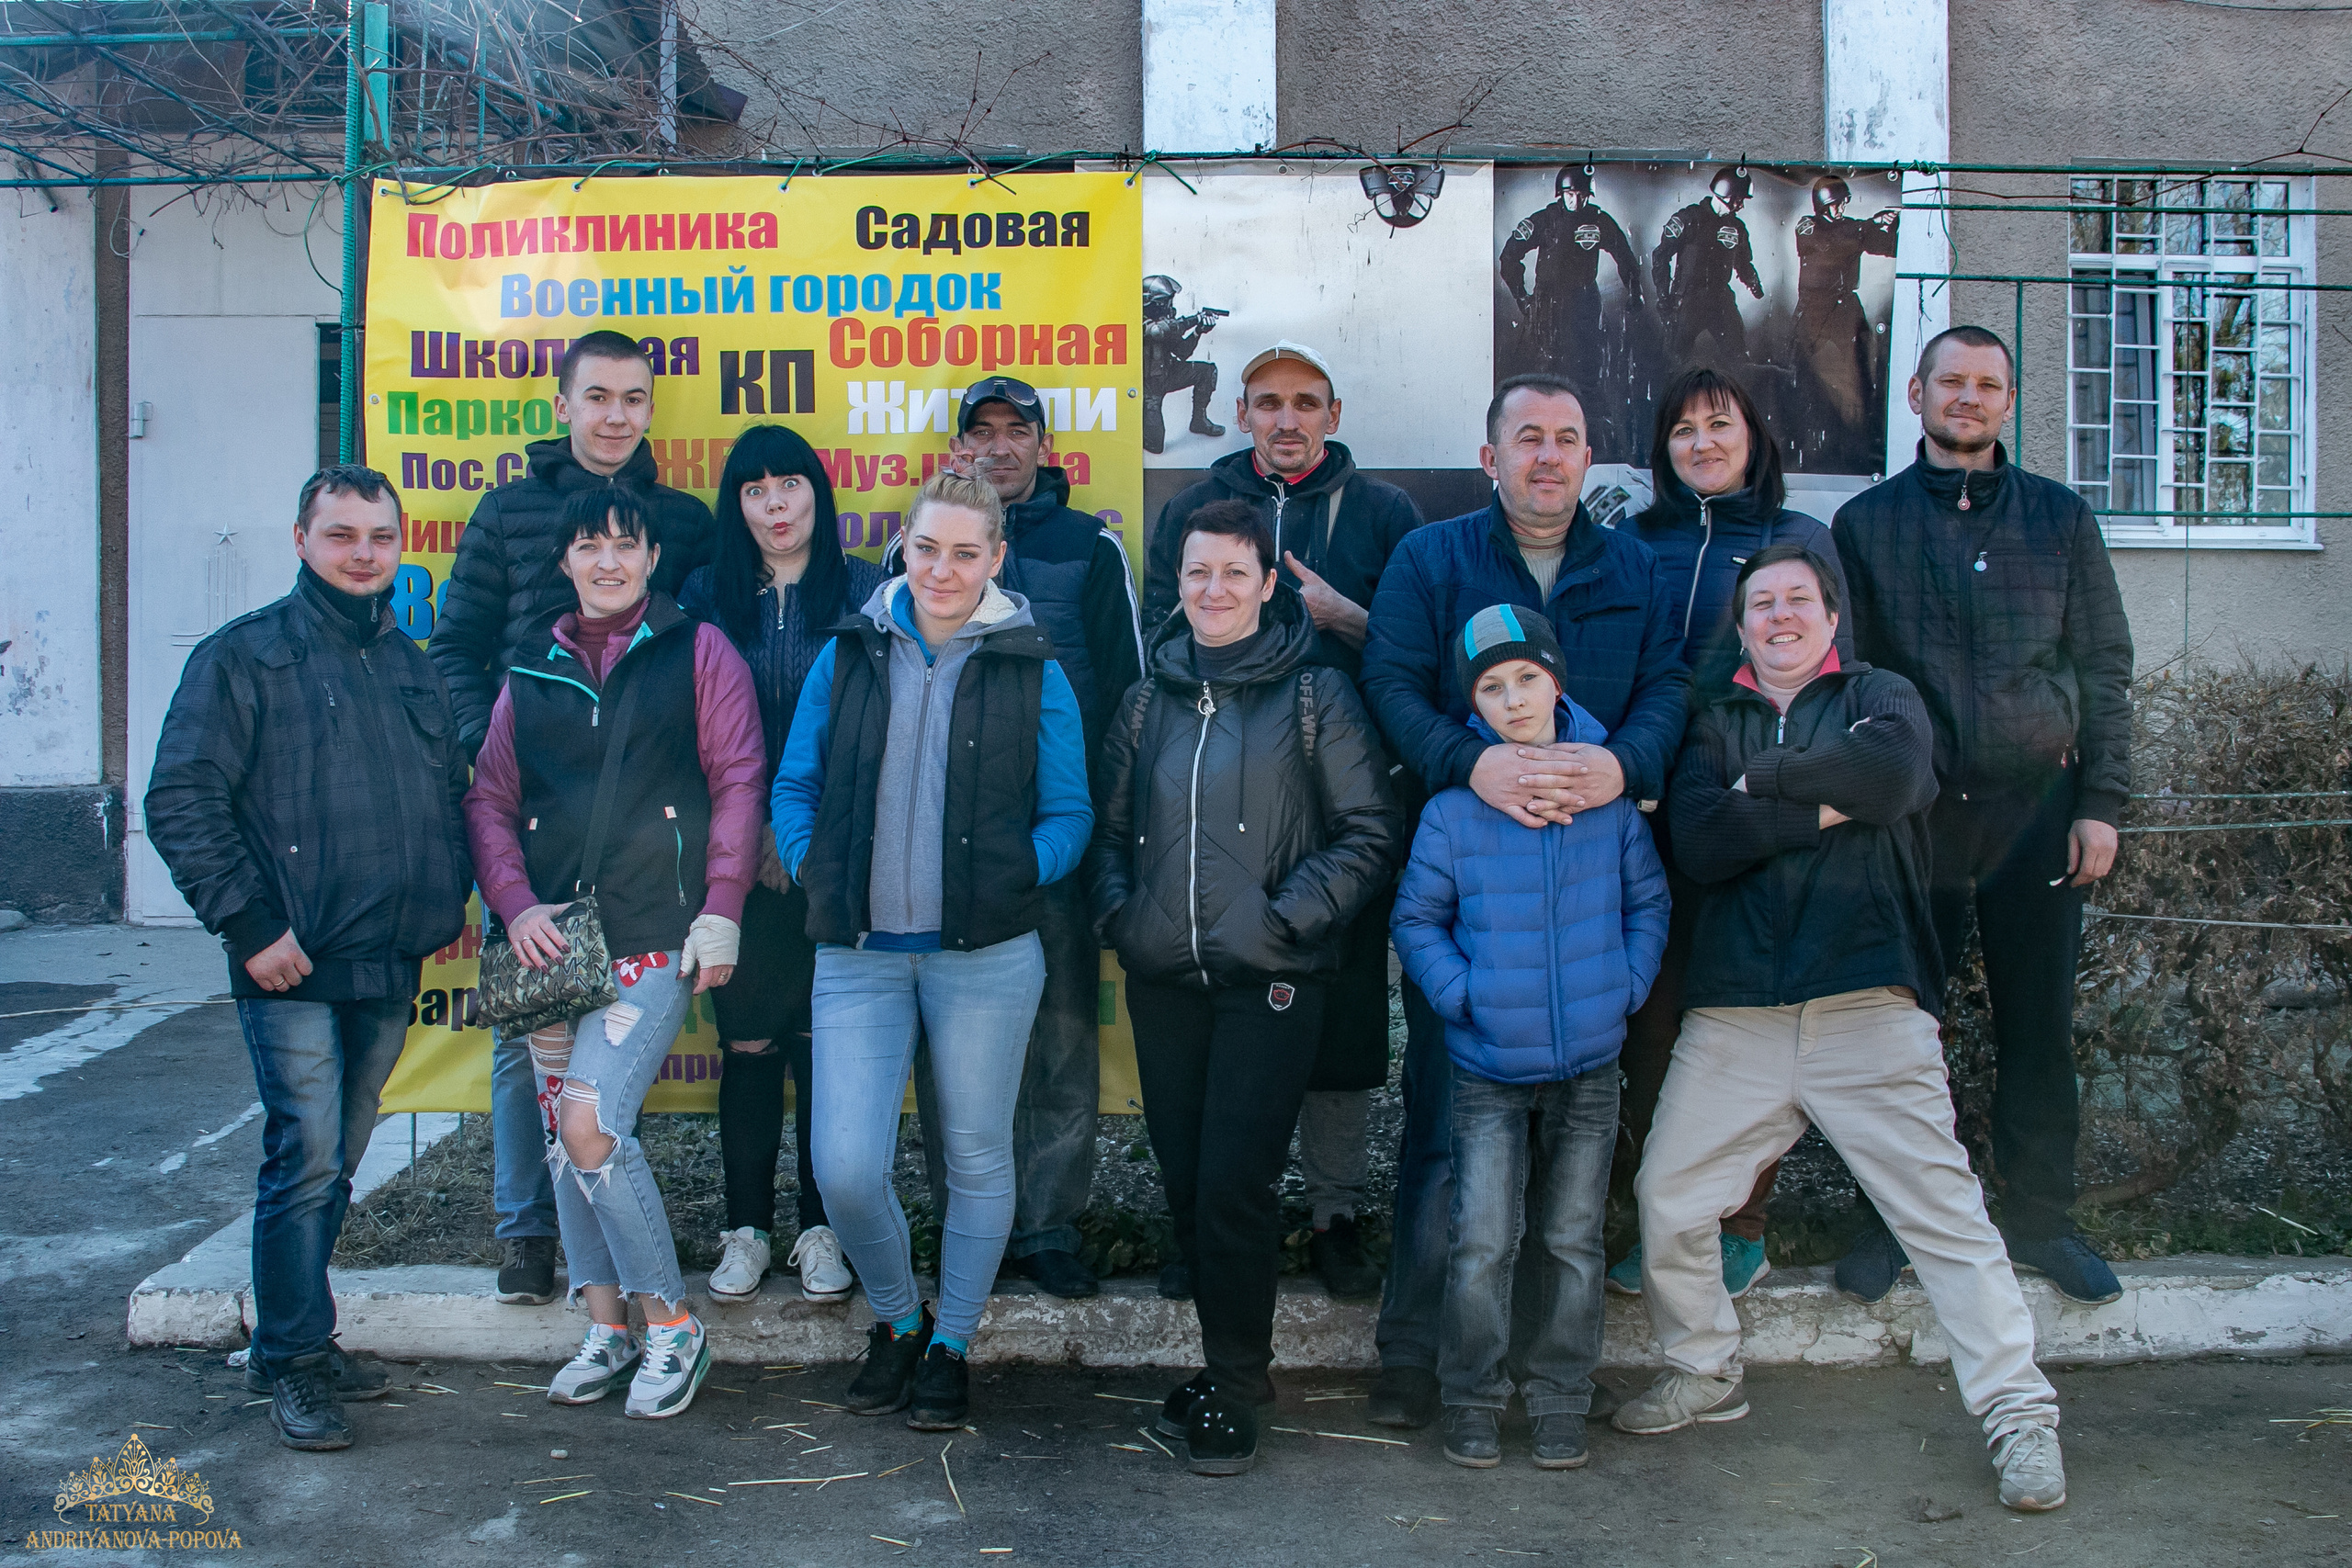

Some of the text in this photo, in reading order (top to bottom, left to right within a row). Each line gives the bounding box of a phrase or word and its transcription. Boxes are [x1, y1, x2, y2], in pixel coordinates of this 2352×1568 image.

[406, 211, 779, 260] Поликлиника
[855, 205, 1090, 256] Садовая
[500, 265, 1002, 318] Военный городок
[410, 331, 700, 378] Школая
[829, 317, 1127, 372] Соборная
[719, 349, 816, 414] КП
[846, 380, 1117, 435] Жили
[387, 391, 650, 441] Парко
